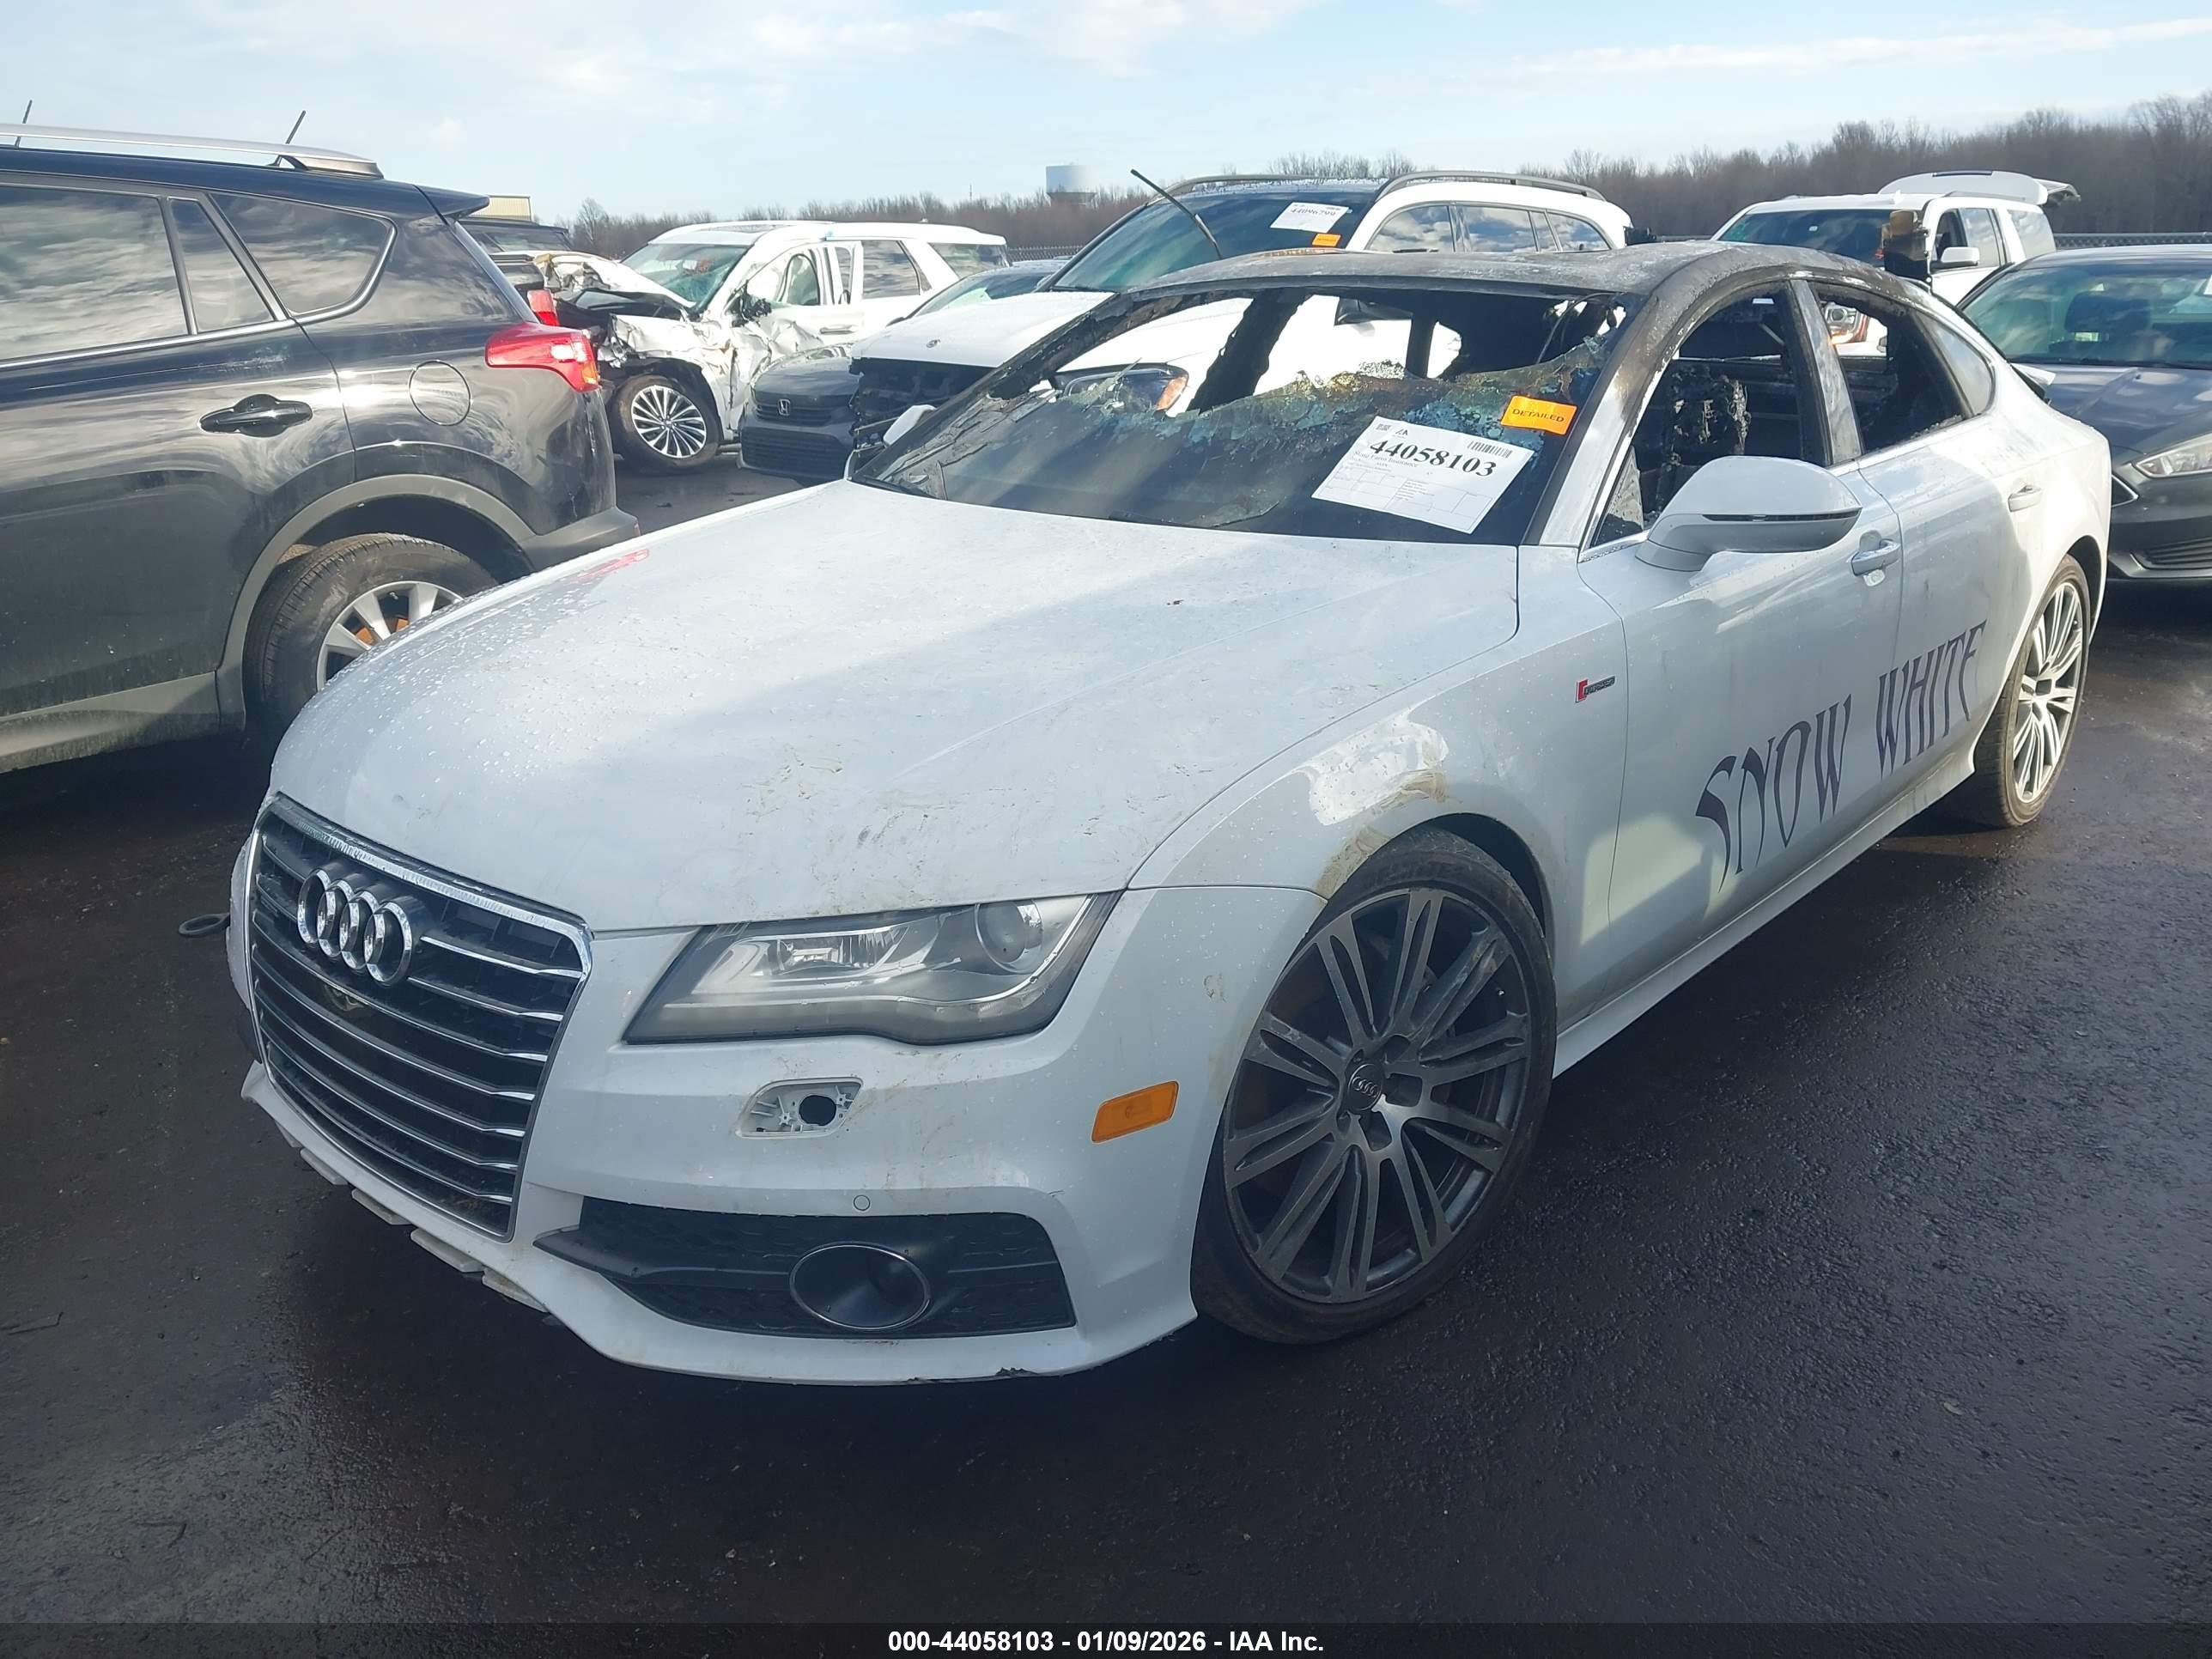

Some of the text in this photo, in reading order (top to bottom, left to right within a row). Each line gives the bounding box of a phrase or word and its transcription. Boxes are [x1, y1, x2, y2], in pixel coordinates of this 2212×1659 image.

[1512, 409, 1565, 422] DETAILED
[1370, 440, 1497, 477] 44058103
[1695, 619, 1987, 894] SNOW WHITE
